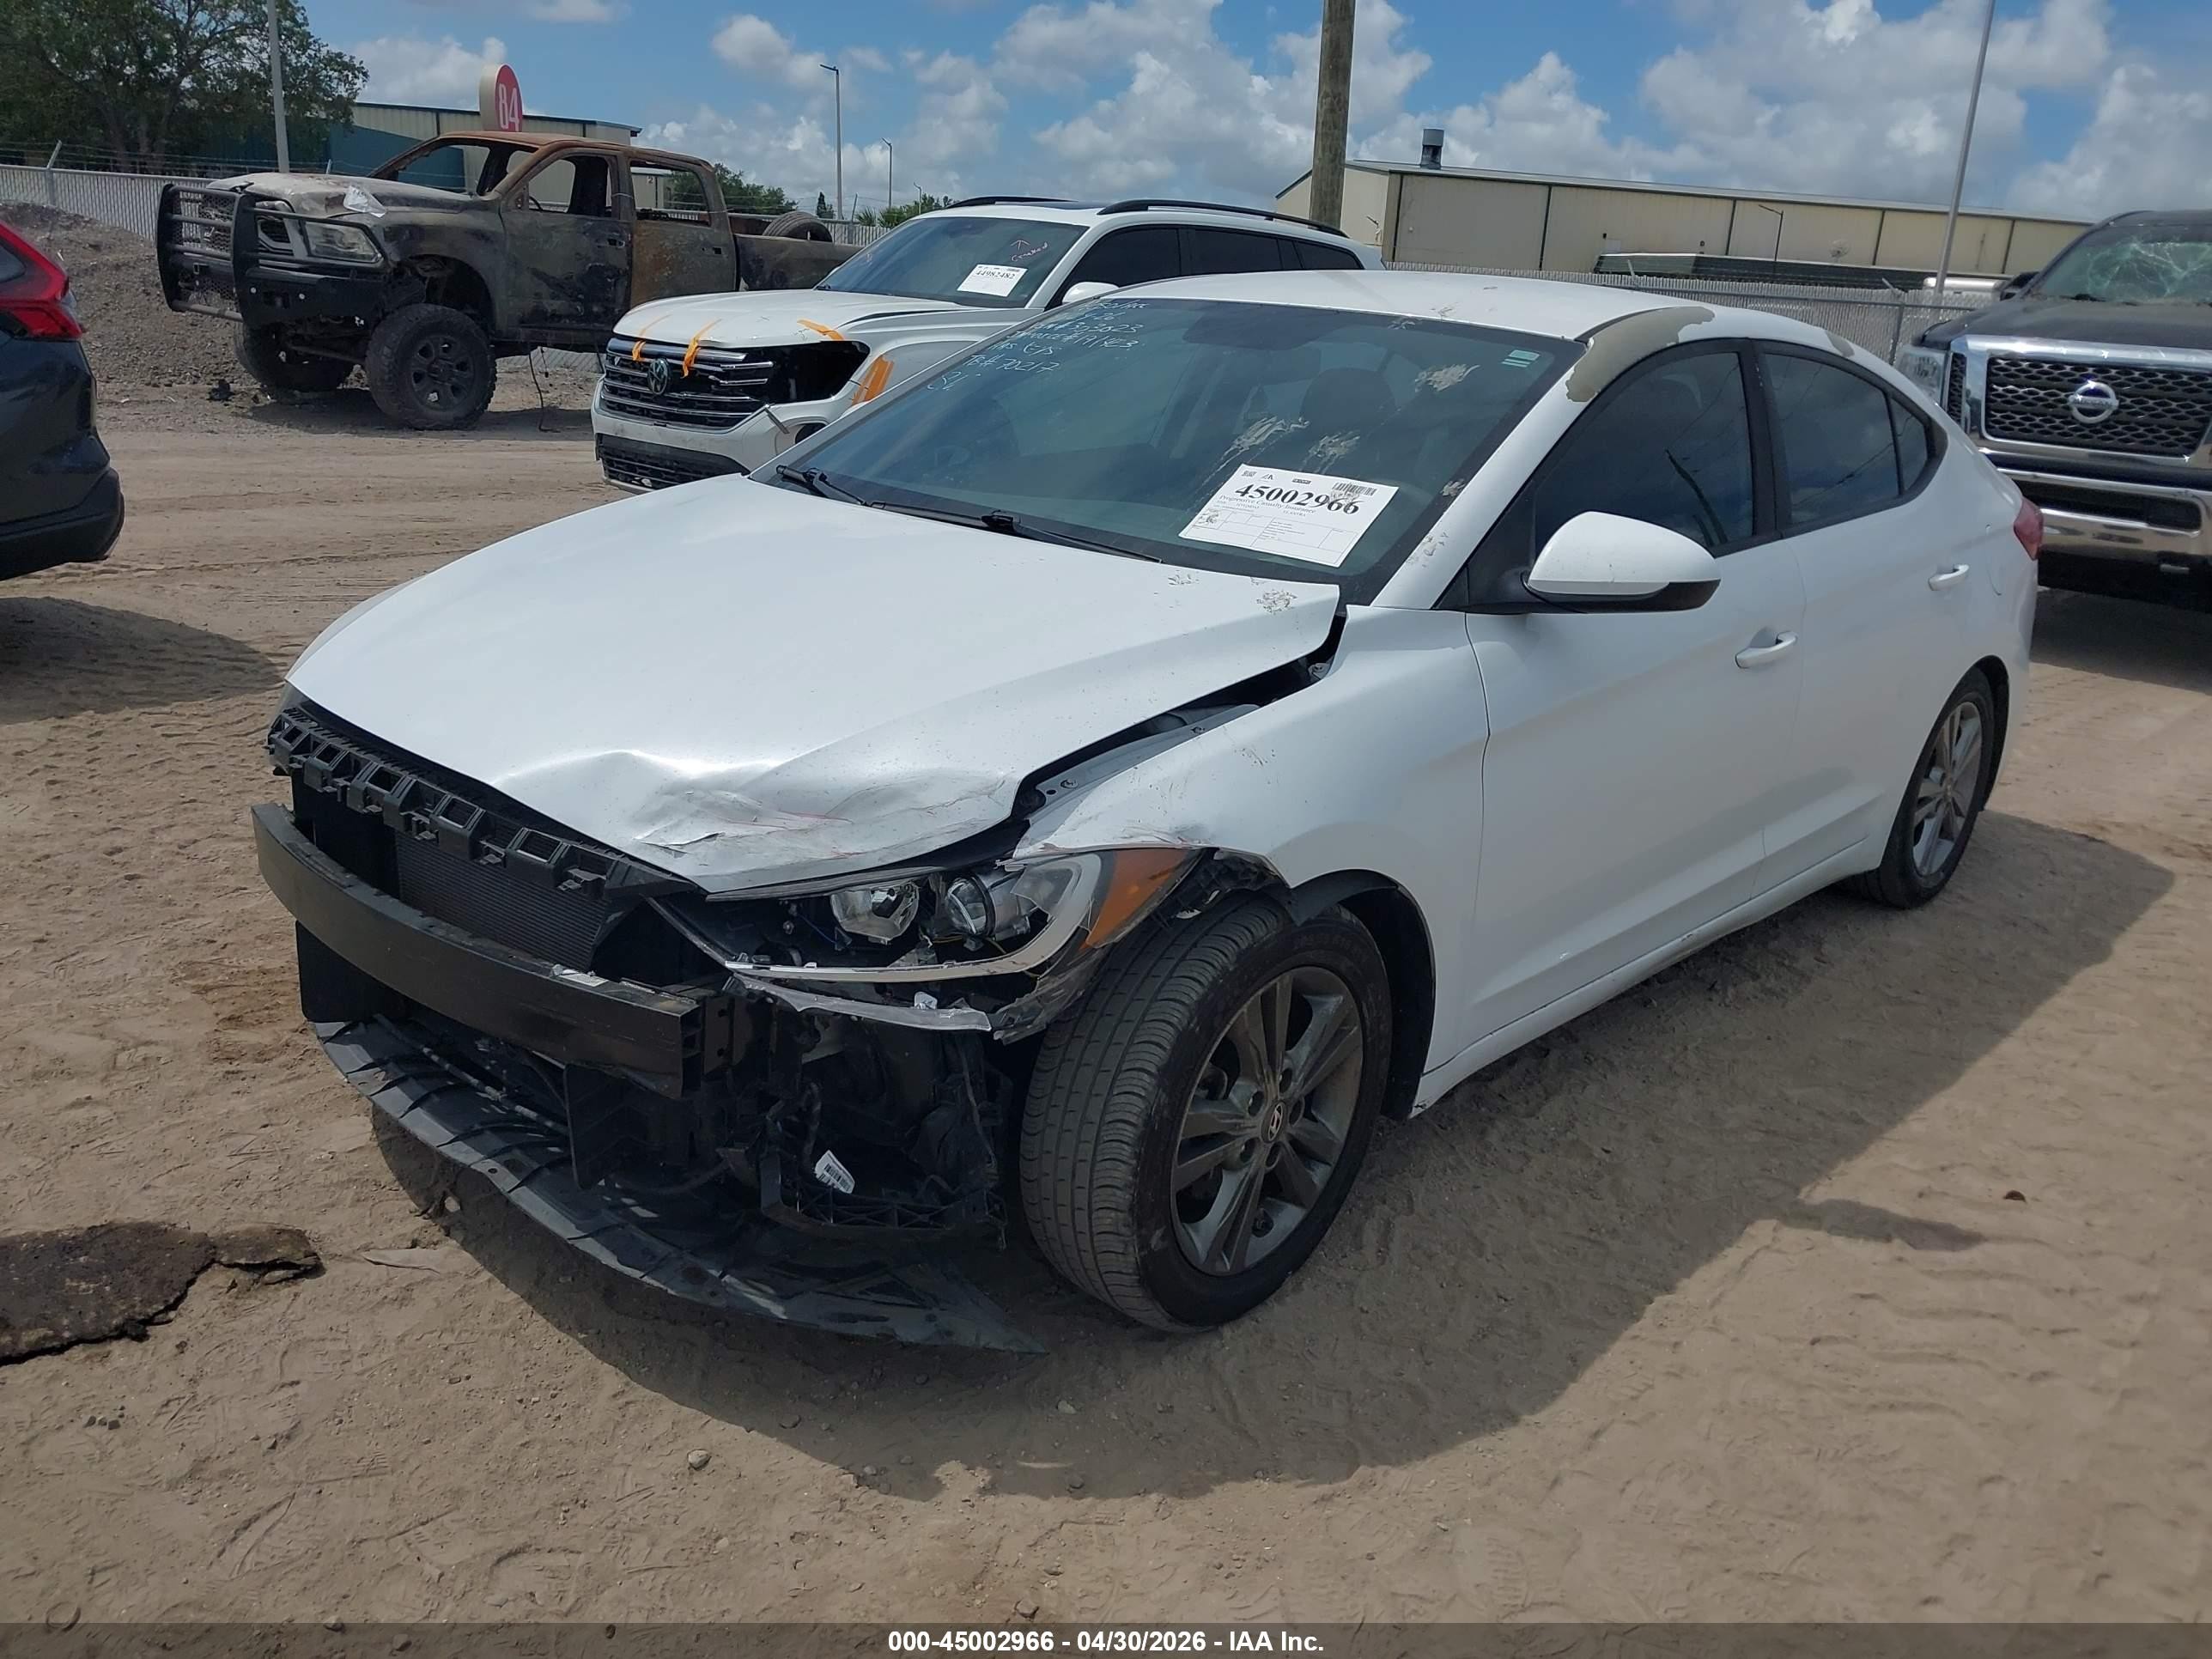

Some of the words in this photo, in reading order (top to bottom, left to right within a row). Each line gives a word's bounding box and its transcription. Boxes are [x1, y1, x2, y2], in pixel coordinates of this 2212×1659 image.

[498, 82, 520, 132] 84
[975, 270, 1016, 279] 44982482
[1235, 483, 1359, 515] 45002966
